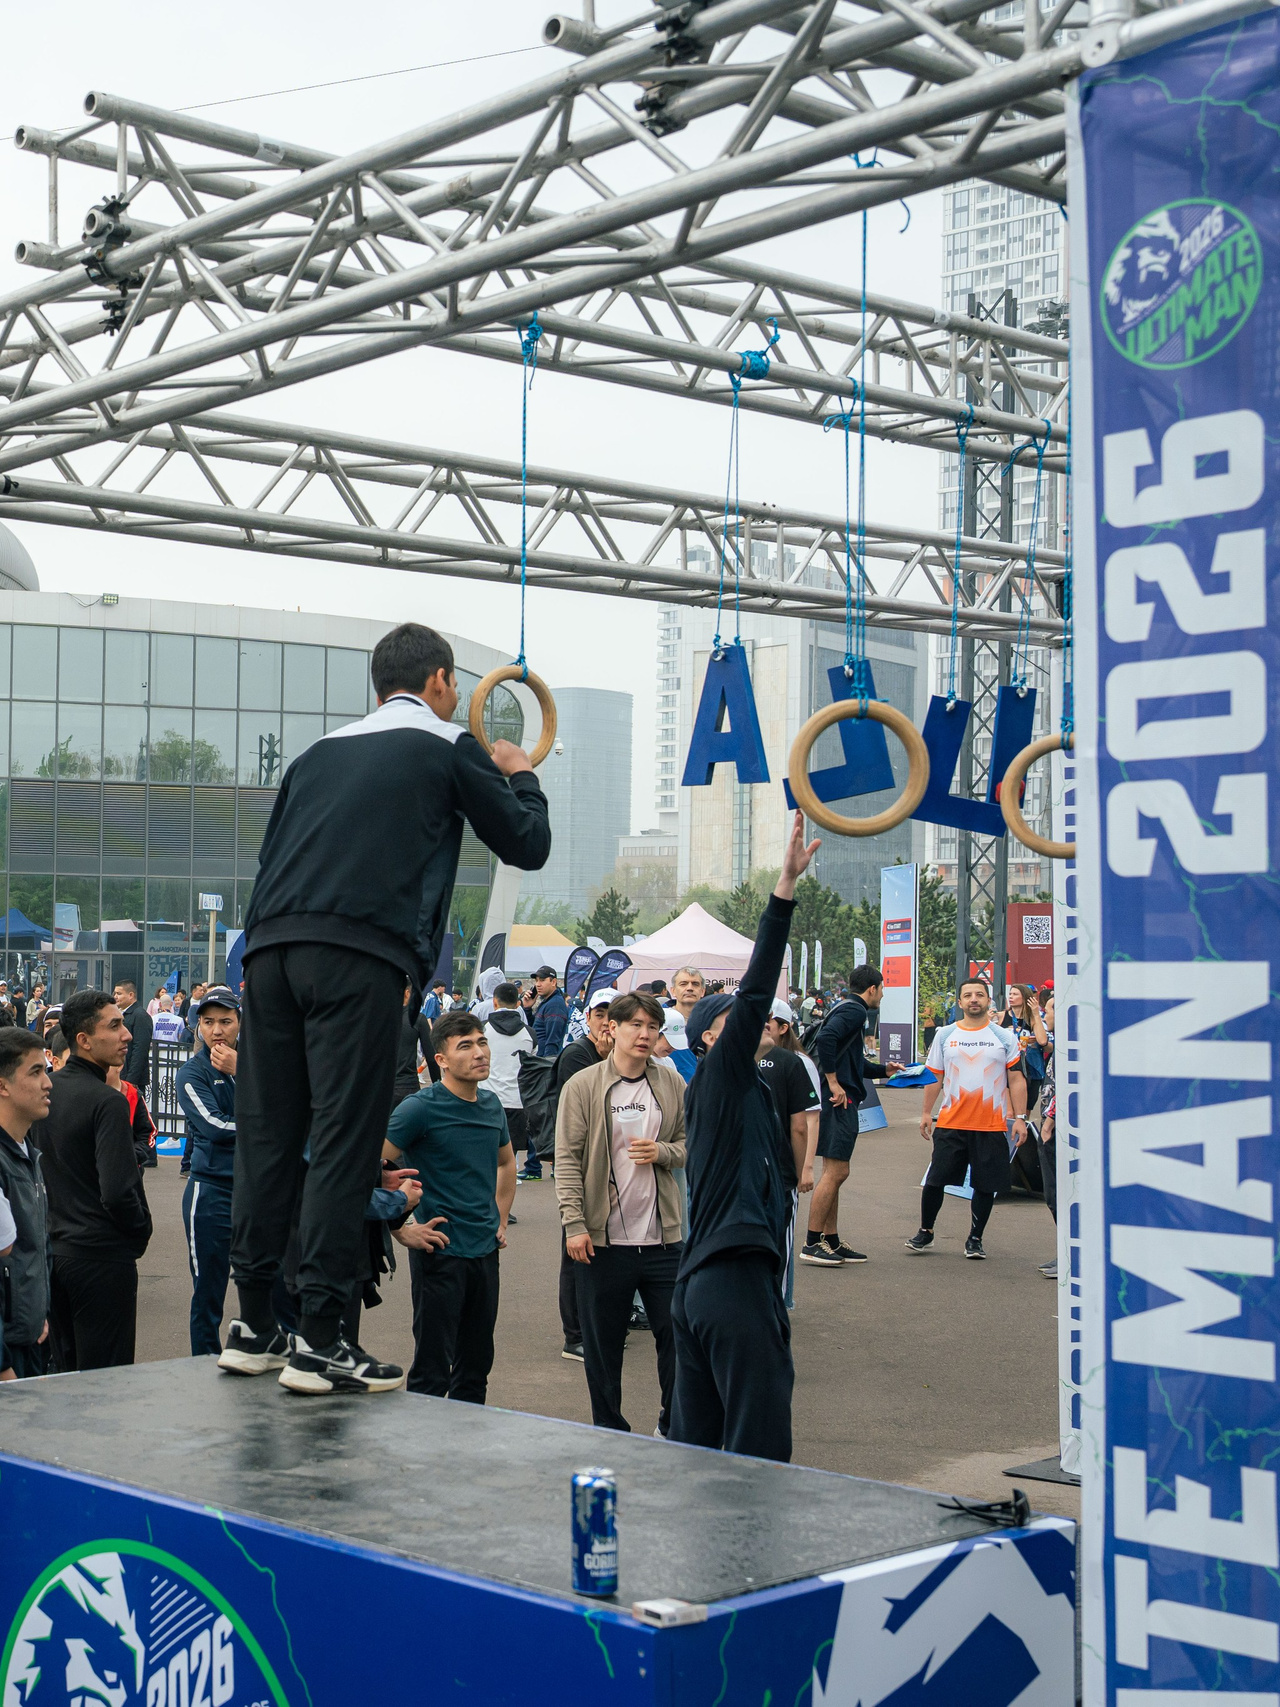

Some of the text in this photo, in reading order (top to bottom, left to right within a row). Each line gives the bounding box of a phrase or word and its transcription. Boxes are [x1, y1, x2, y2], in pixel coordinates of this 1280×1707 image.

[1126, 236, 1255, 362] ULTIMATE
[1185, 266, 1256, 360] MAN
[1102, 408, 1268, 878] 2026
[705, 977, 742, 987] ensilis
[1107, 961, 1277, 1383] MAN
[1114, 1445, 1280, 1707] TE
